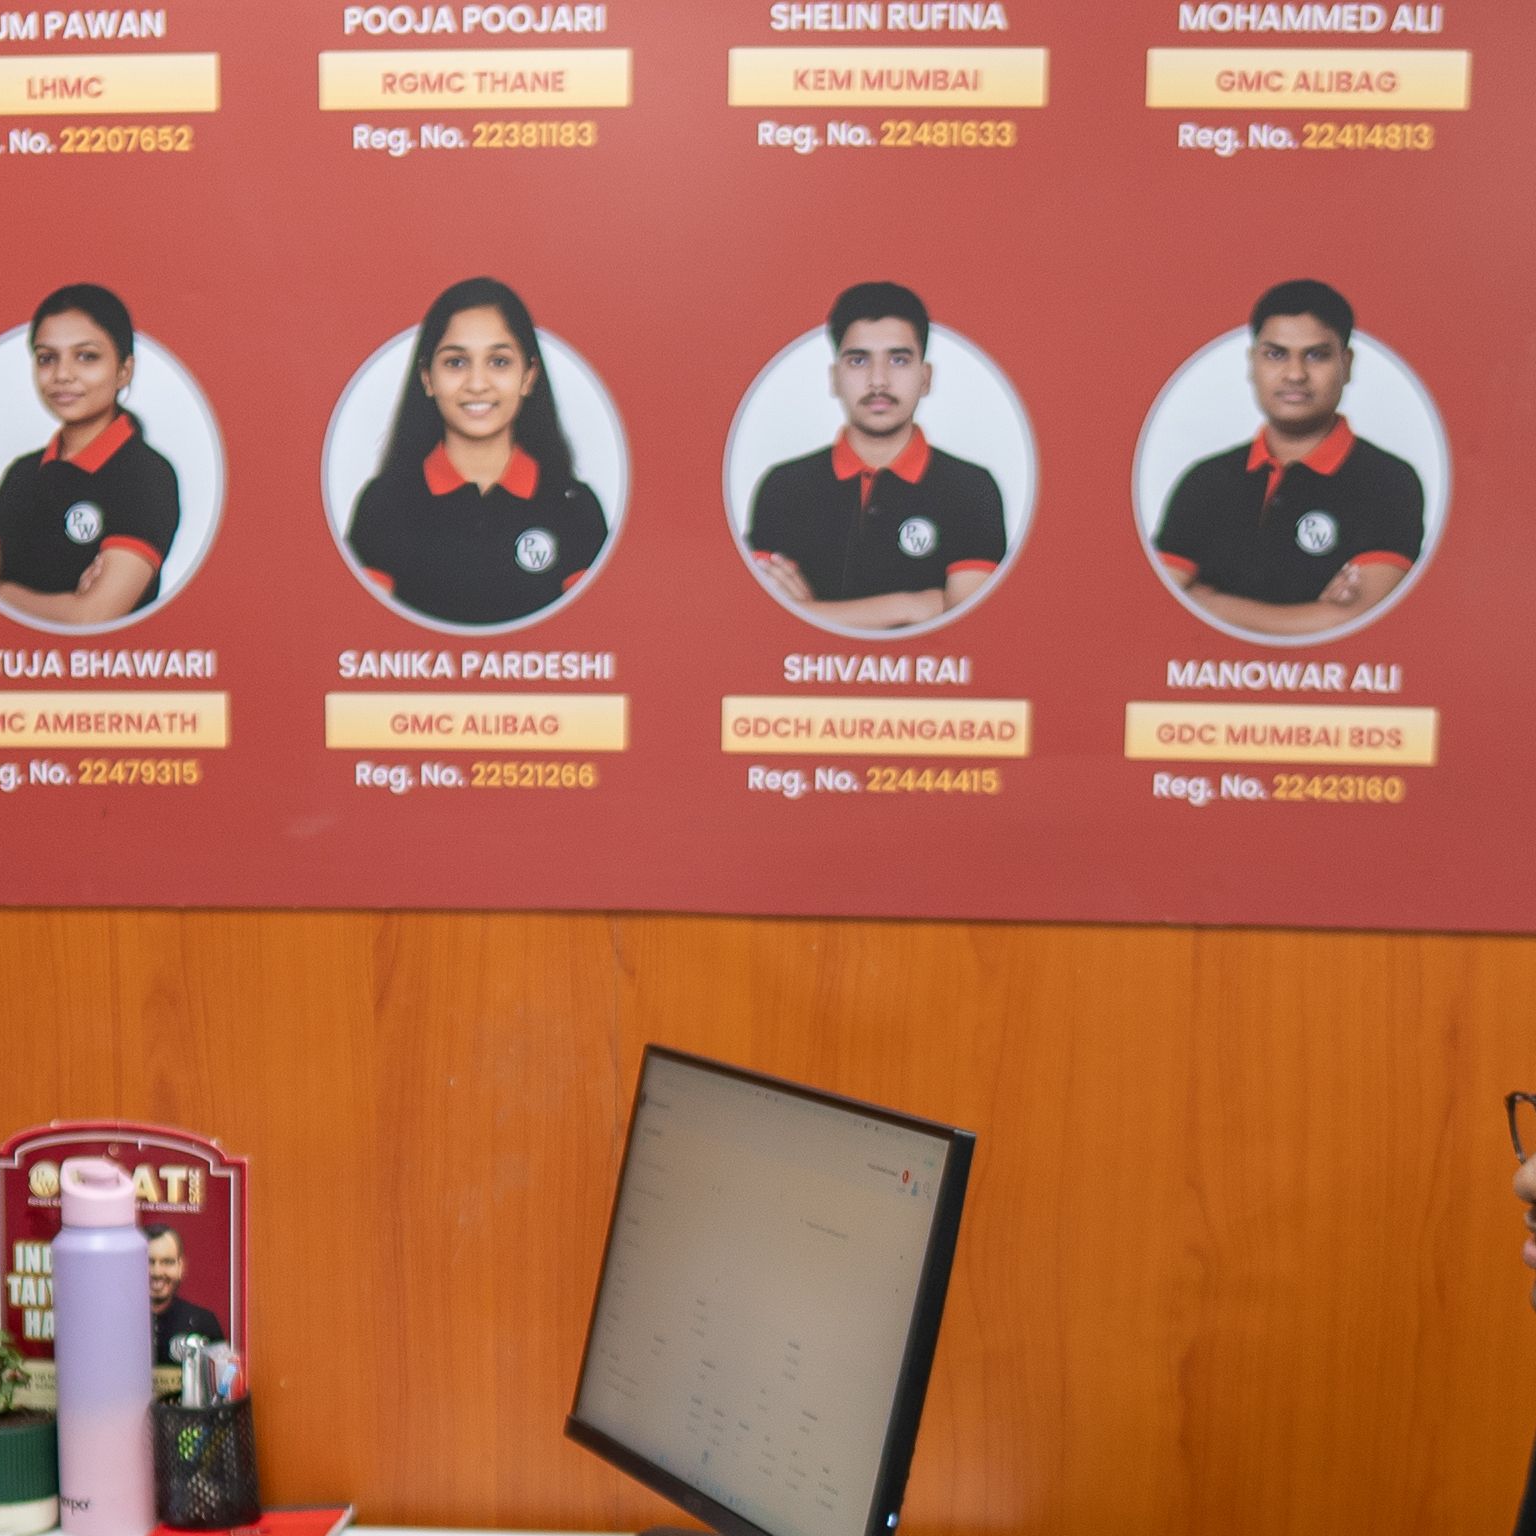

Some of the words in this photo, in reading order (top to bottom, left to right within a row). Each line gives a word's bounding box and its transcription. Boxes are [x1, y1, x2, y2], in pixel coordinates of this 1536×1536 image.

[43, 9, 166, 40] PAWAN
[343, 5, 457, 35] POOJA
[462, 3, 607, 34] POOJARI
[770, 1, 882, 31] SHELIN
[887, 2, 1008, 31] RUFINA
[1178, 2, 1387, 33] MOHAMMED
[1390, 4, 1443, 34] ALI
[26, 76, 104, 100] LHMC
[381, 71, 466, 95] RGMC
[474, 70, 565, 94] THANE
[794, 68, 854, 92] KEM
[860, 68, 981, 92] MUMBAI
[1215, 69, 1285, 94] GMC
[1291, 70, 1399, 94] ALIBAG
[8, 128, 56, 154] No.
[60, 126, 192, 153] 22207652
[352, 123, 417, 157] Reg.
[420, 124, 469, 149] No.
[473, 121, 596, 147] 22381183
[757, 120, 823, 155] Reg.
[826, 121, 876, 147] No.
[880, 121, 1013, 146] 22481633
[1177, 122, 1244, 157] Reg.
[1248, 123, 1298, 150] No.
[1302, 123, 1432, 149] 22414813
[70, 649, 216, 678] BHAWARI
[338, 650, 456, 679] SANIKA
[461, 651, 615, 680] PARDESHI
[783, 654, 911, 683] SHIVAM
[915, 655, 970, 684] RAI
[1166, 660, 1347, 691] MANOWAR
[1350, 663, 1401, 693] ALI
[33, 712, 198, 734] AMBERNATH
[390, 713, 454, 735] GMC
[461, 714, 560, 736] ALIBAG
[732, 716, 813, 739] GDCH
[819, 718, 1018, 743] AURANGABAD
[1156, 723, 1217, 746] GDC
[1225, 724, 1342, 749] MUMBAI
[1348, 726, 1404, 750] BDS
[29, 760, 73, 785] No.
[78, 760, 200, 784] 22479315
[355, 761, 415, 794] Reg.
[420, 762, 465, 787] No.
[472, 763, 596, 787] 22521266
[747, 765, 809, 799] Reg.
[814, 767, 860, 792] No.
[867, 768, 999, 793] 22444415
[1152, 772, 1215, 807] Reg.
[1220, 774, 1267, 800] No.
[1273, 775, 1402, 801] 22423160
